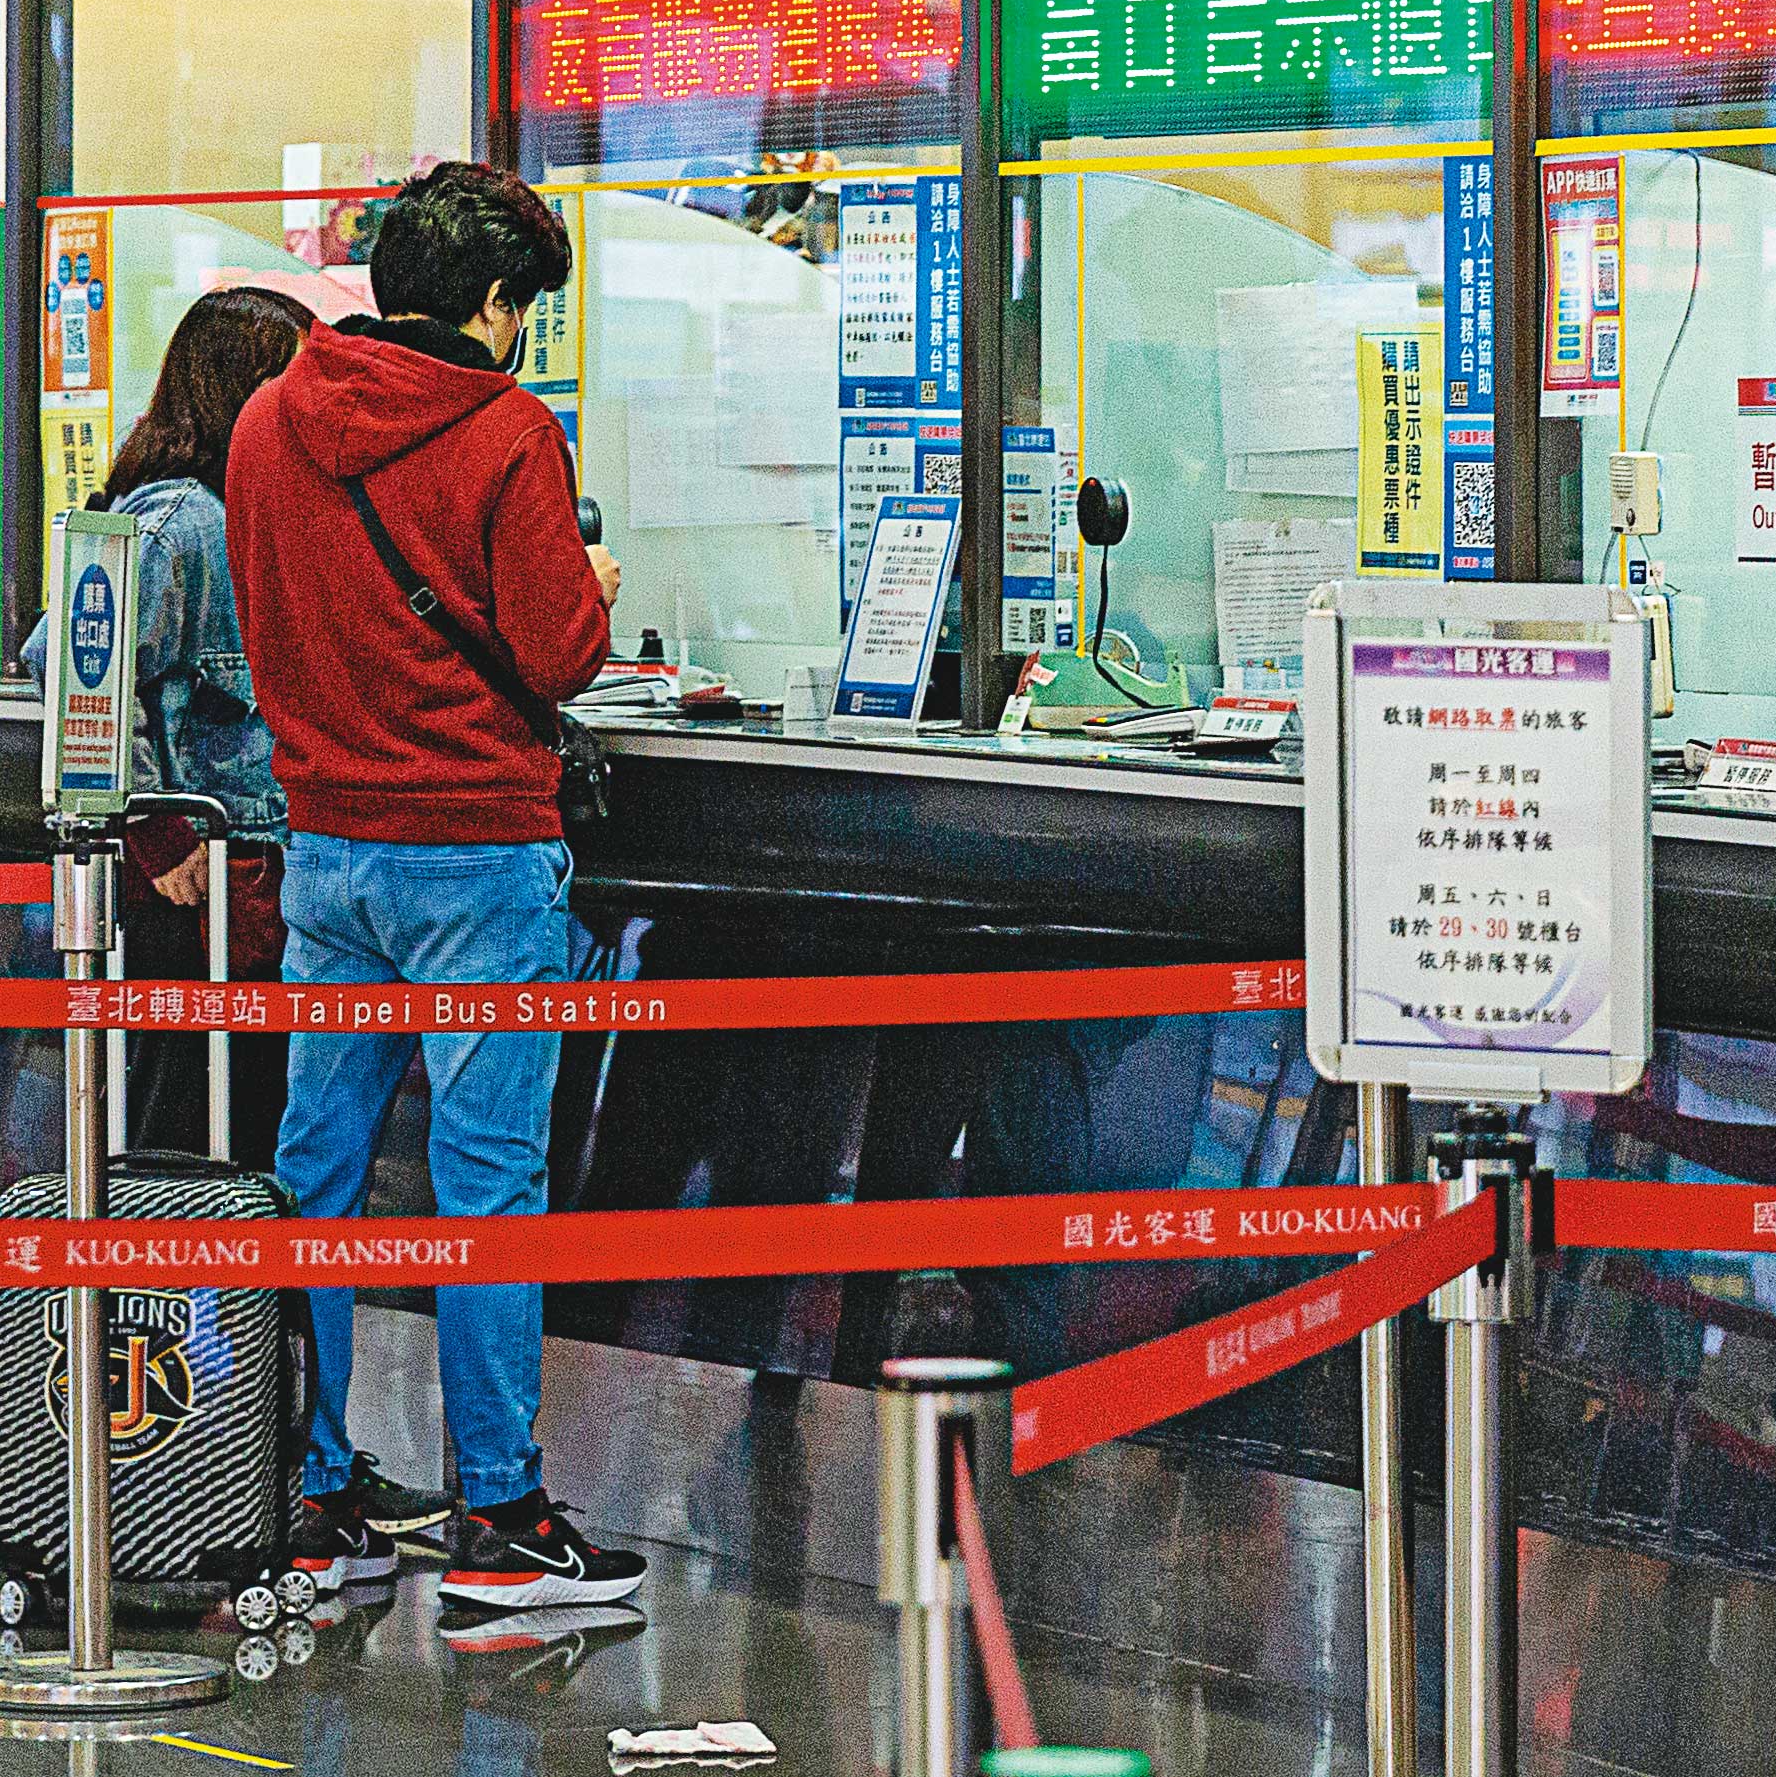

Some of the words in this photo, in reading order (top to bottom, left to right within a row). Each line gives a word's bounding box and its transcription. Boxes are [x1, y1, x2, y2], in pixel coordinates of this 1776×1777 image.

[1459, 164, 1475, 374] 請洽1樓服務台
[1404, 341, 1421, 508] 請出示證件
[1383, 342, 1399, 543] 購買優惠票種
[1454, 647, 1555, 675] 國光客運
[1429, 763, 1540, 784] 周一至周四
[1418, 830, 1551, 851] 依序排隊等候
[1417, 951, 1553, 976] 依序排隊等候
[66, 986, 267, 1025] 臺北轉運站
[286, 991, 412, 1029] Taipei
[436, 994, 495, 1023] Bus
[516, 991, 665, 1024] Station
[1064, 1209, 1214, 1247] 國光客運
[1240, 1208, 1421, 1235] KUO-KUANG
[67, 1240, 259, 1265] KUO-KUANG
[290, 1238, 474, 1267] TRANSPORT
